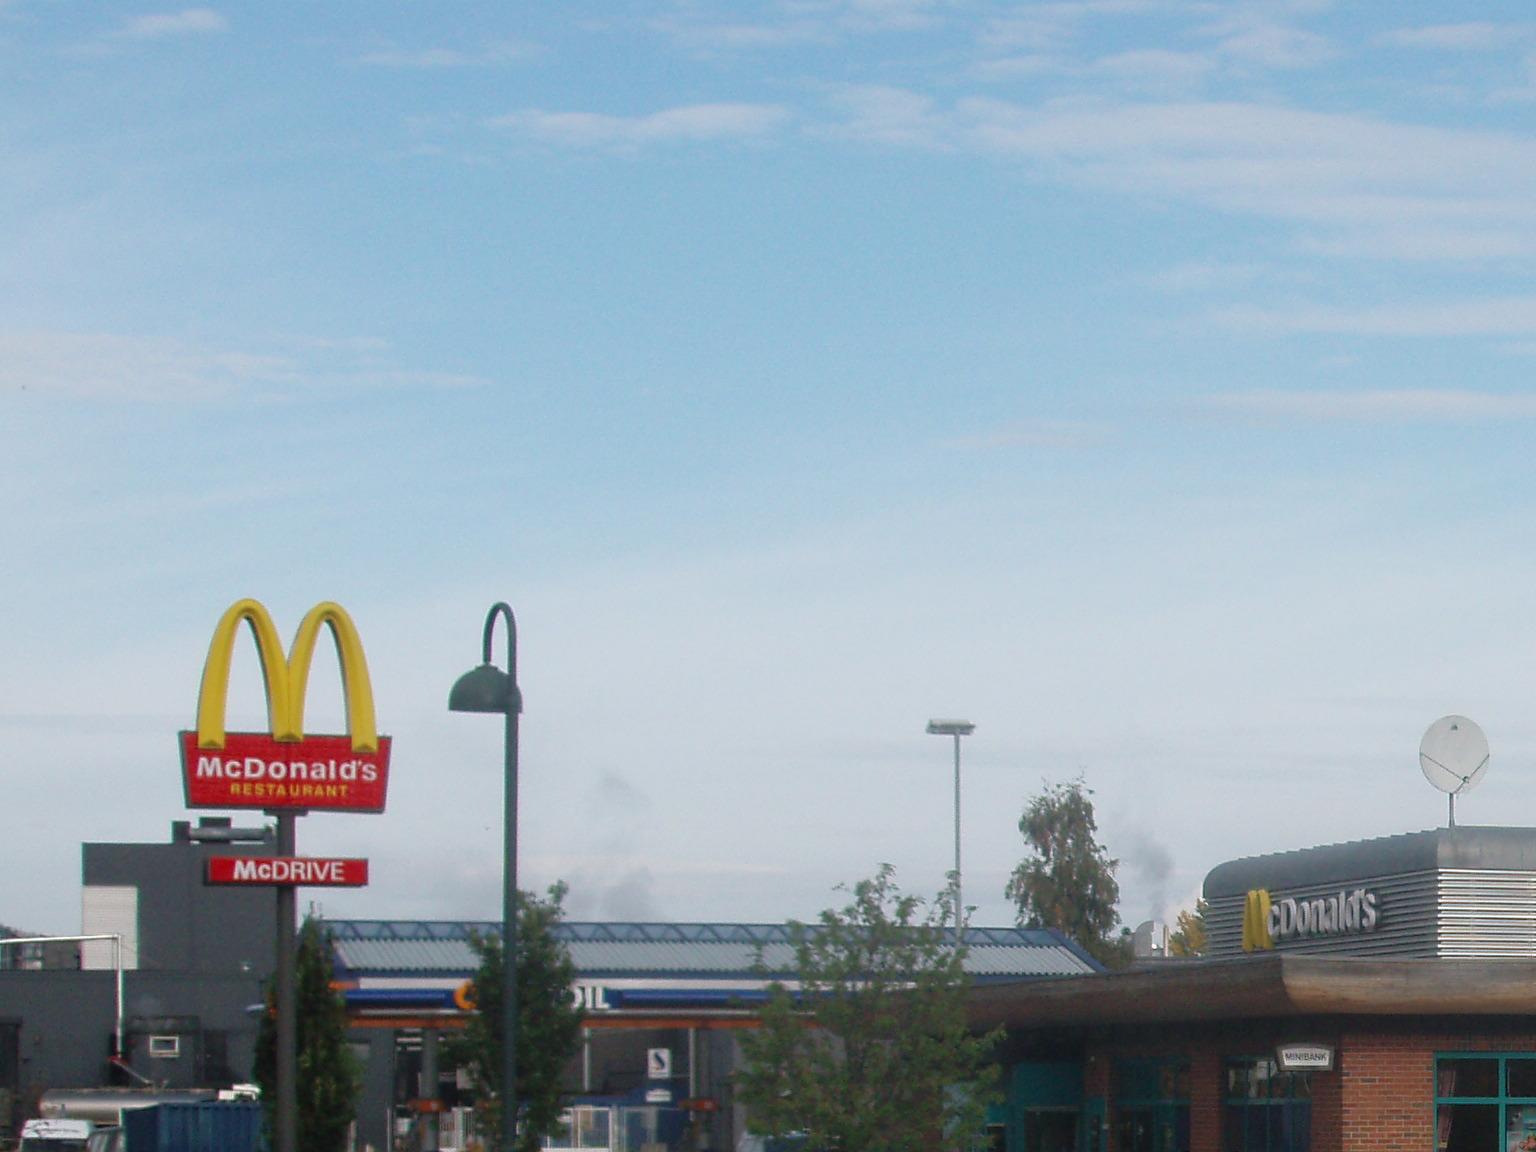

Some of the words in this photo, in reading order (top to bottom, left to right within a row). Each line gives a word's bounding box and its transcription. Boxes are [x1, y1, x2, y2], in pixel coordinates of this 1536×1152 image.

[196, 756, 377, 781] McDonald's
[230, 783, 348, 797] RESTAURANT
[232, 860, 345, 881] McDRIVE
[1242, 888, 1376, 951] McDonald's
[1285, 1052, 1327, 1061] MINIBANK
